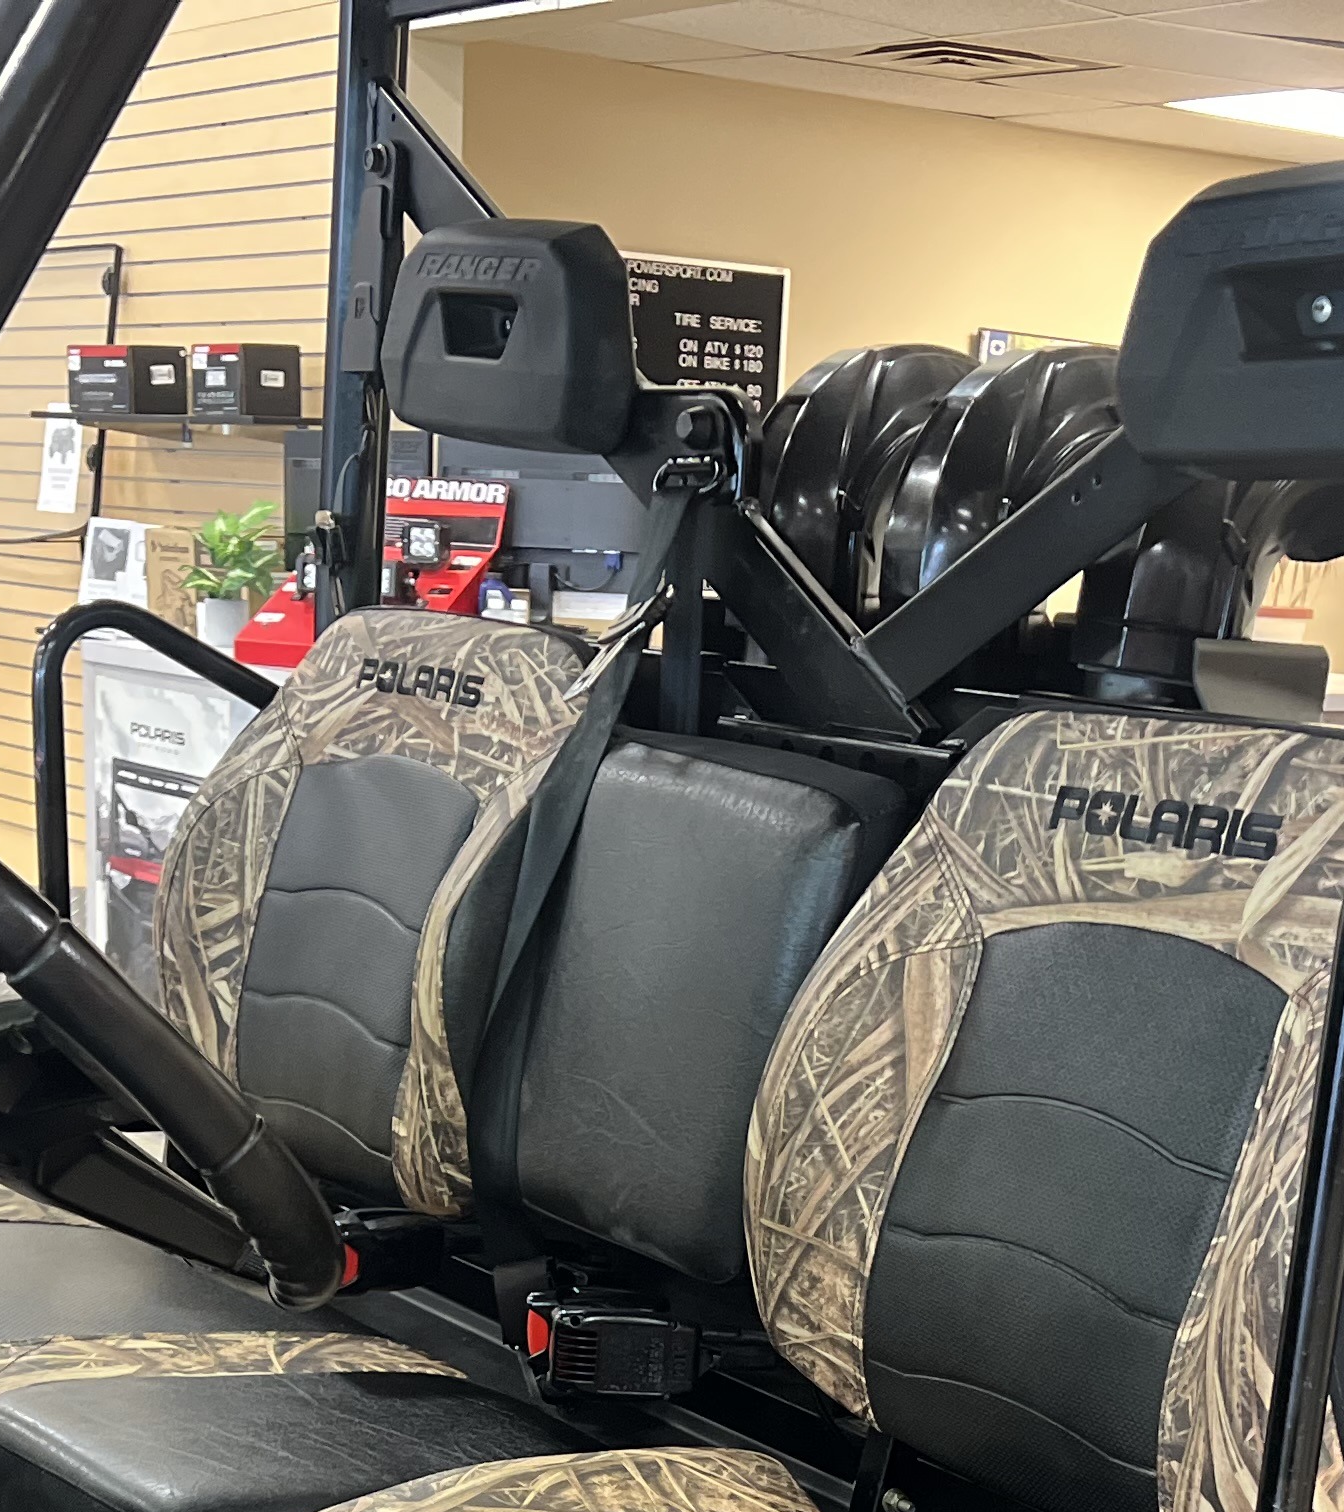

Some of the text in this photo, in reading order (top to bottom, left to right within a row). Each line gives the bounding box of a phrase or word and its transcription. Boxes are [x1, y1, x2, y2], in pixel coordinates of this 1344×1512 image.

[417, 252, 543, 281] RANGER
[674, 312, 701, 328] TIRE
[679, 338, 698, 353] ON
[705, 341, 729, 355] ATV
[678, 354, 698, 368] ON
[704, 356, 730, 370] BIKE
[412, 479, 506, 504] ARMOR
[357, 658, 485, 708] POLARIS
[130, 721, 186, 747] POLARIS
[1049, 785, 1284, 860] POLARIS
